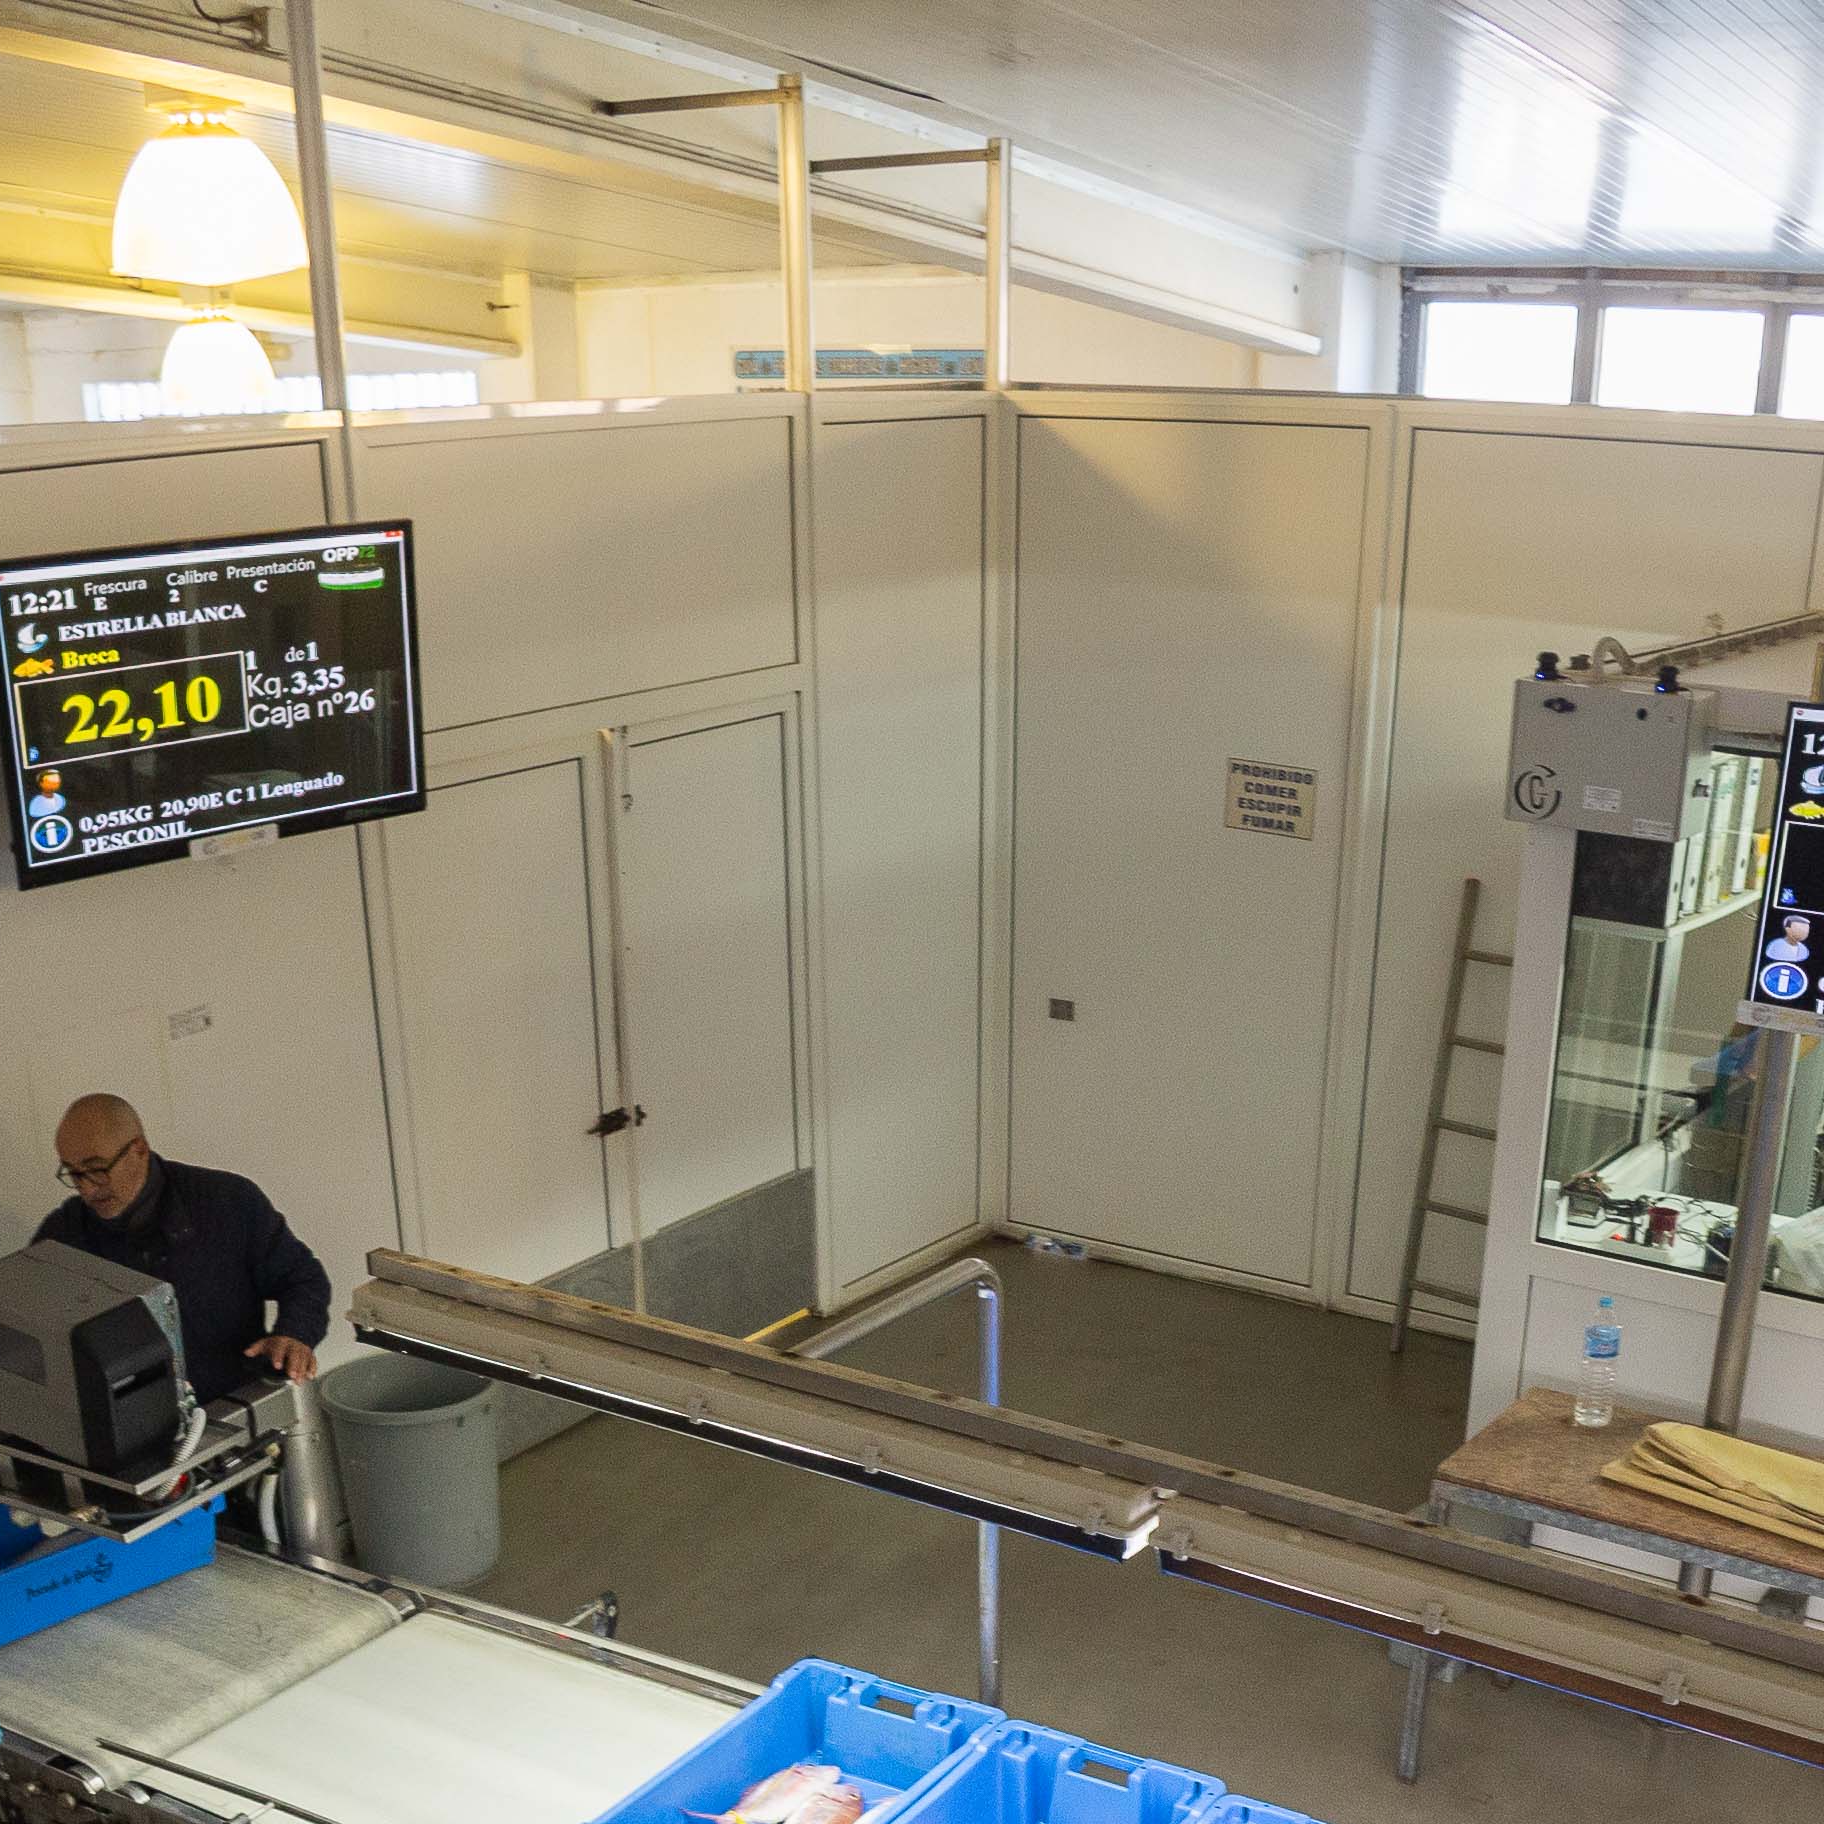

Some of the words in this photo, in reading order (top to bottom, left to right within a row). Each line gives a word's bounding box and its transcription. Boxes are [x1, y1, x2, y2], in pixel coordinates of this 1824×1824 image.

[8, 588, 76, 617] 12:21
[84, 577, 147, 597] Frescura
[166, 567, 218, 588] Calibre
[226, 557, 315, 580] Presentación
[94, 597, 107, 612] E
[169, 589, 180, 603] 2
[253, 579, 268, 593] C
[58, 609, 162, 642] ESTRELLA
[166, 603, 246, 629] BLANCA
[61, 647, 120, 670] Breca
[246, 651, 257, 670] 1
[61, 676, 222, 744] 22,10
[248, 702, 310, 731] Caja
[1231, 763, 1313, 785] PROHIBIDO
[79, 806, 152, 833] 0,95KG
[226, 789, 243, 806] C
[246, 787, 257, 803] 1
[261, 772, 345, 800] Lenguado
[1245, 781, 1297, 800] COMER
[1237, 797, 1302, 817] ESCUPIR
[82, 820, 193, 855] PESCONIL
[1242, 814, 1296, 832] FUMAR
